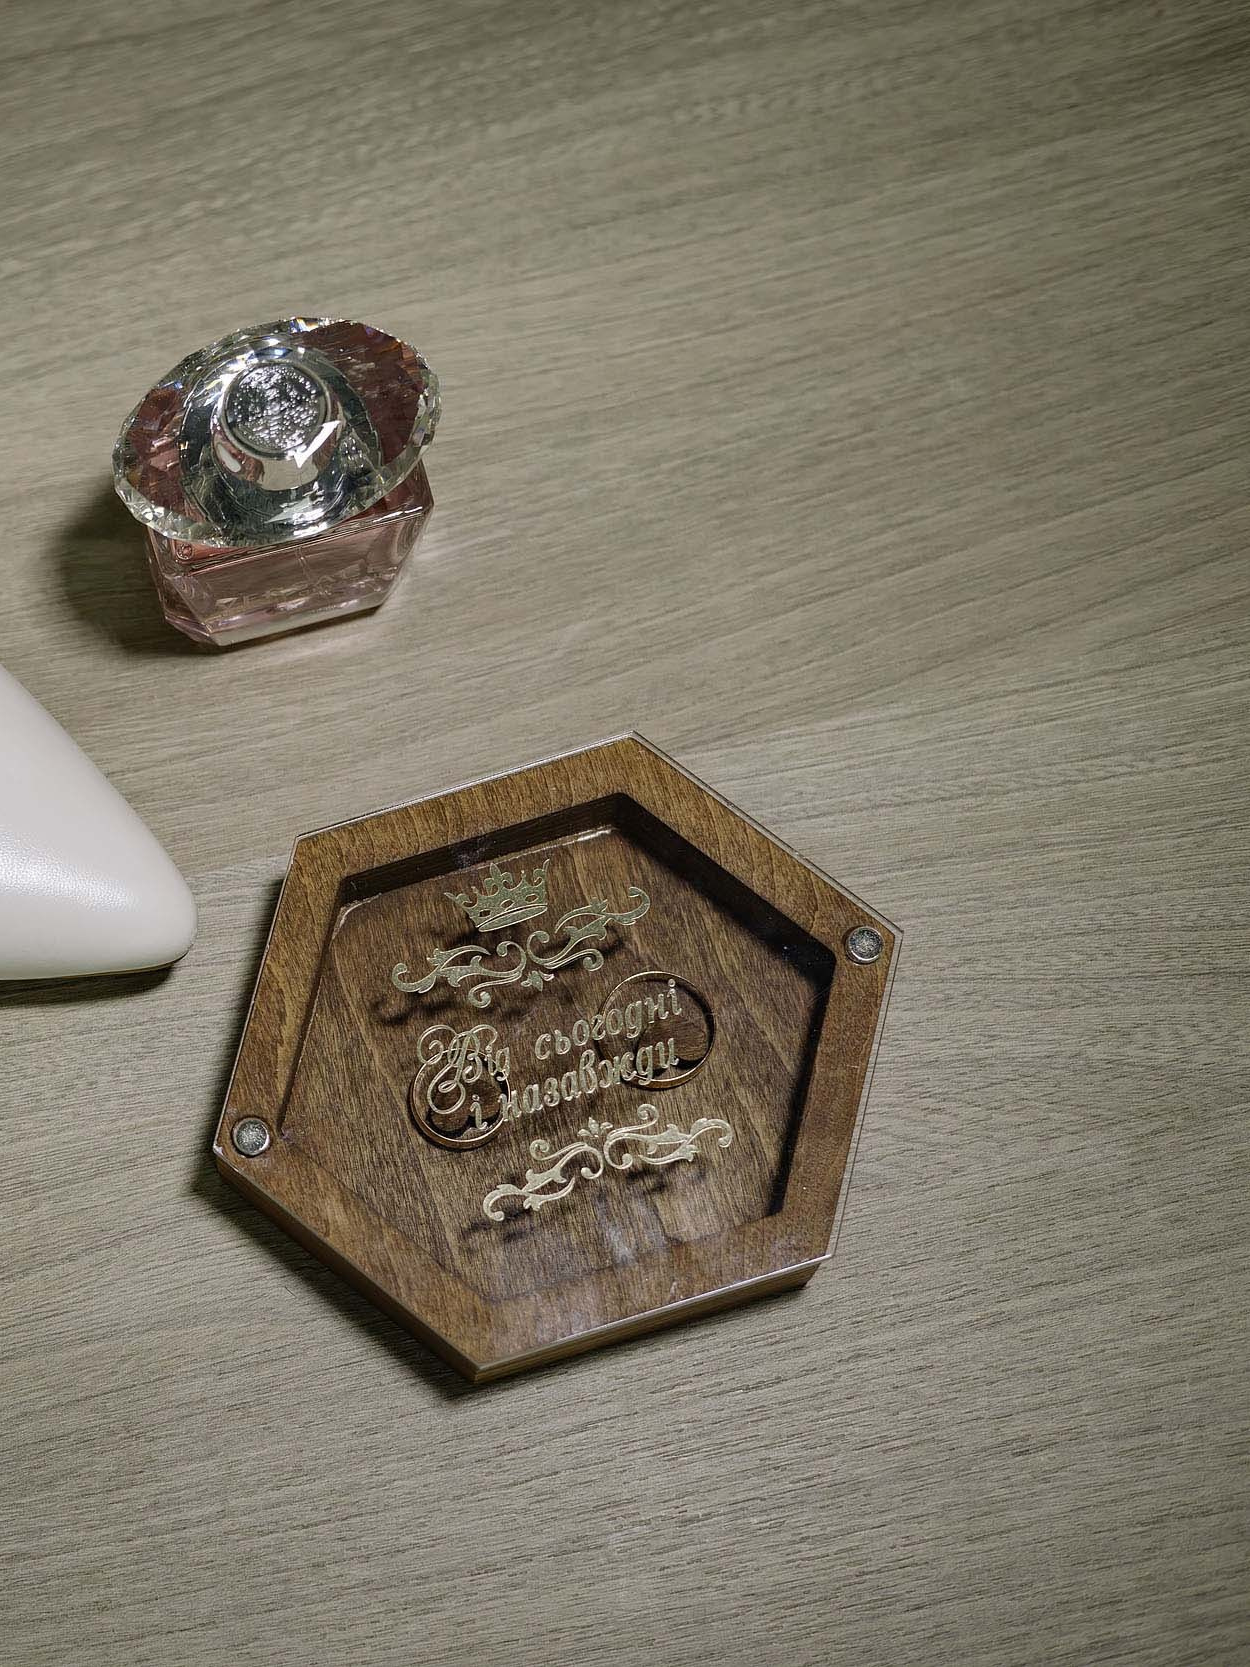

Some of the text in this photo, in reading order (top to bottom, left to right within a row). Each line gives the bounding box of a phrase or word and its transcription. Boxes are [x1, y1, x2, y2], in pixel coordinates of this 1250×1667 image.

[417, 979, 684, 1115] Від сьогодні
[470, 1038, 680, 1131] і назавжди
